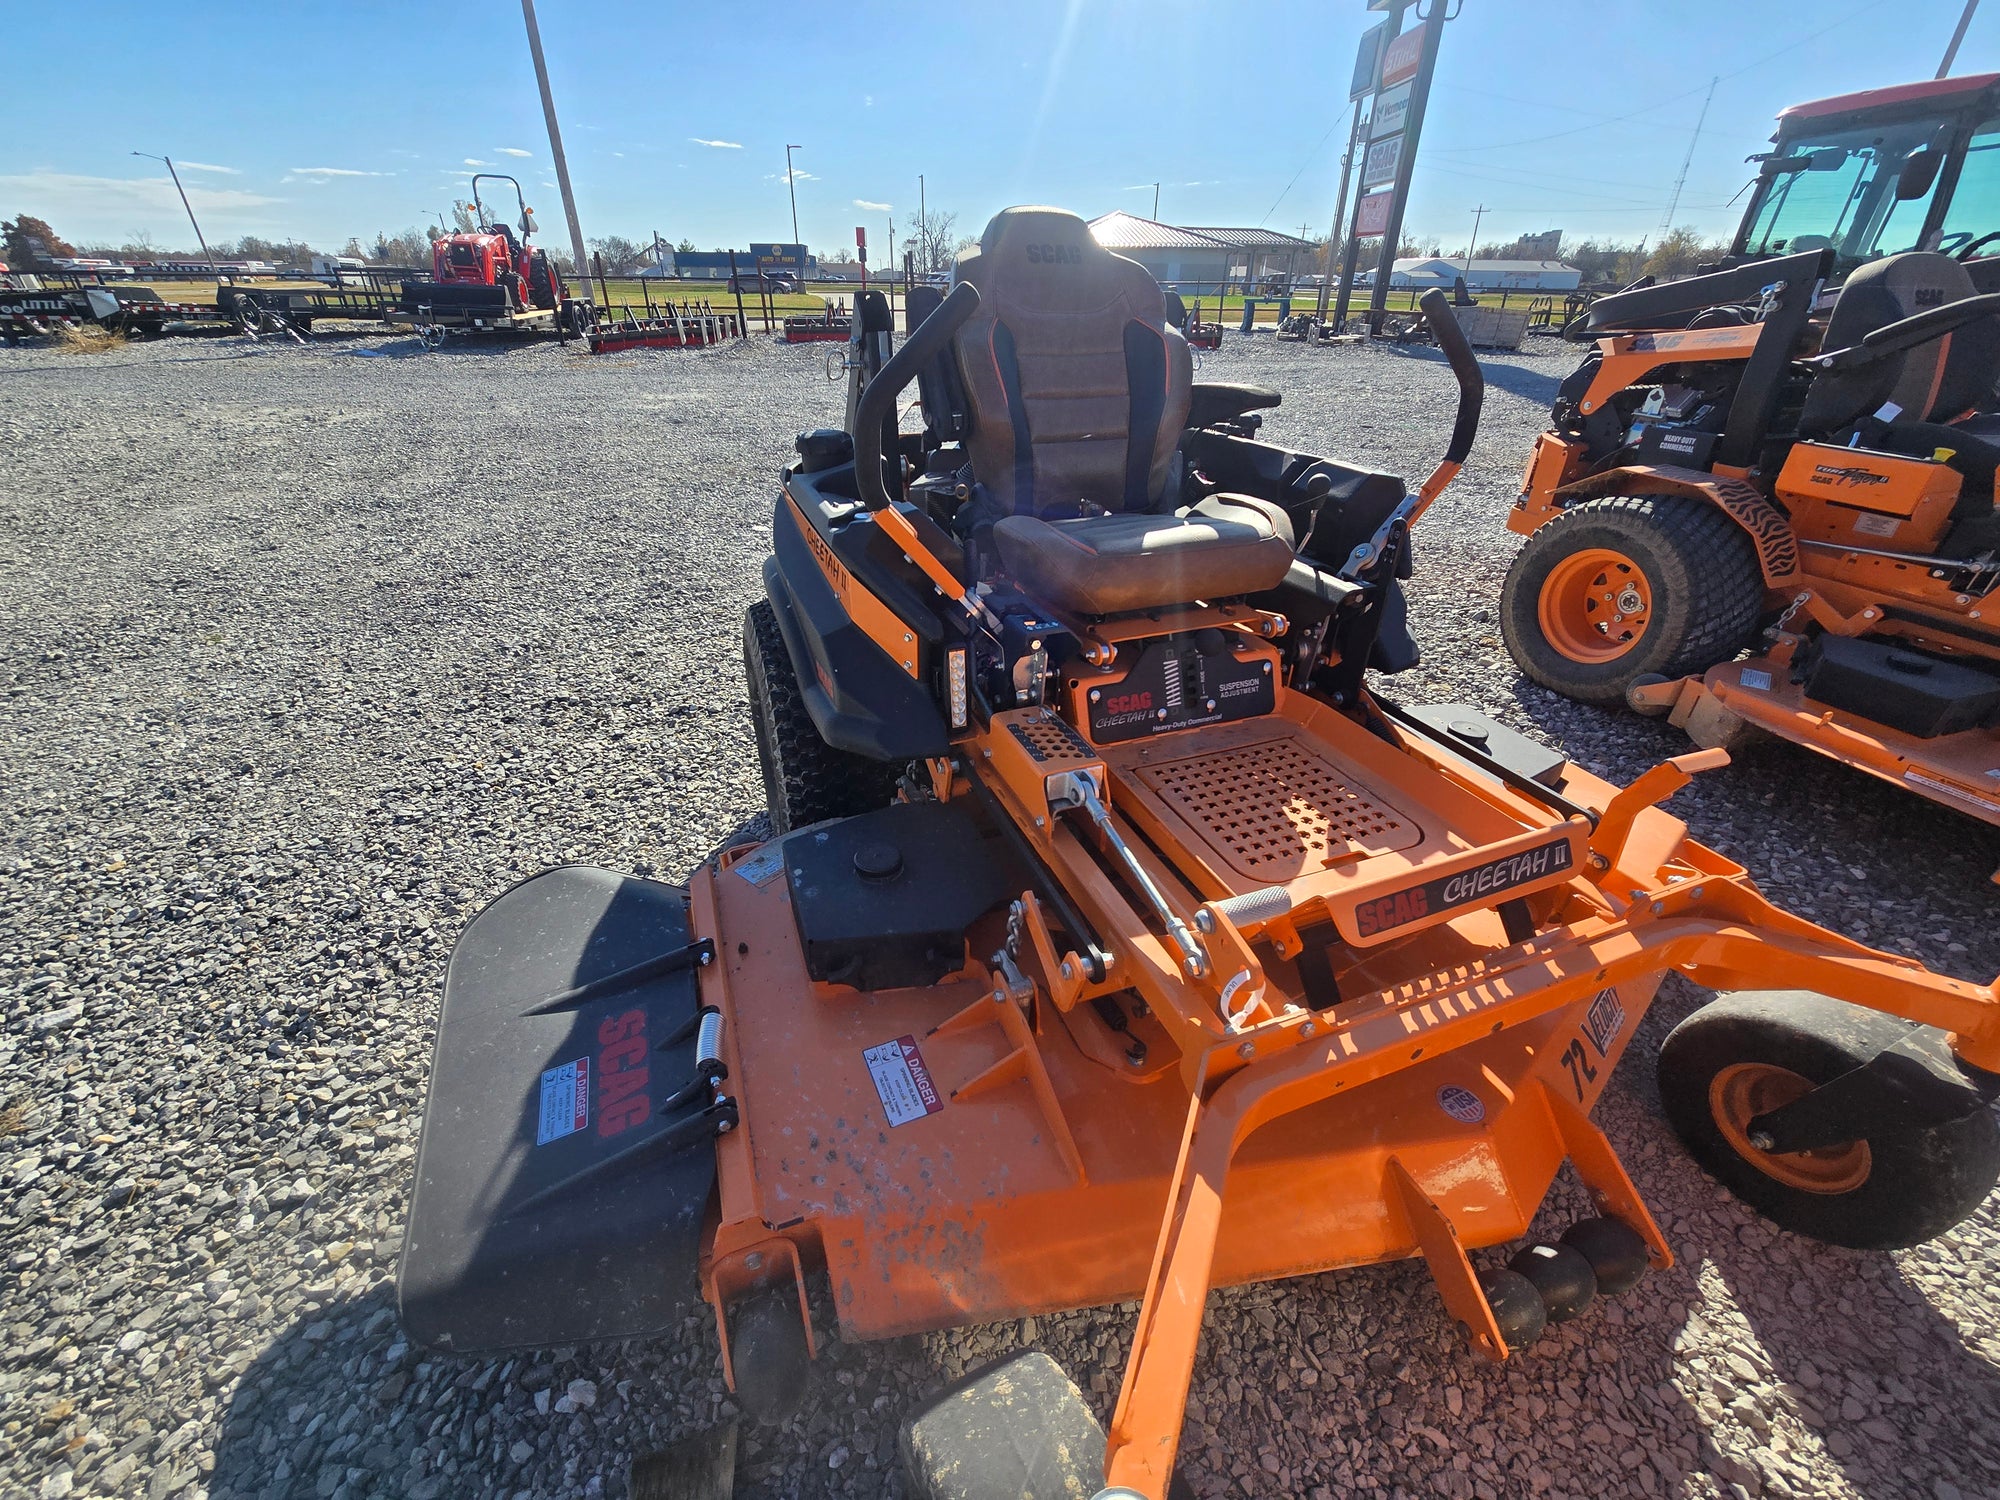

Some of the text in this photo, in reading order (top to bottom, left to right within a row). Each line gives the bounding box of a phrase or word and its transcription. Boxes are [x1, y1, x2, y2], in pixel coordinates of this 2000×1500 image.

[1368, 141, 1398, 171] SCAG
[1026, 243, 1081, 264] SCAG
[22, 300, 67, 310] LITTLE
[1915, 289, 1944, 306] SCAG
[1810, 475, 1833, 485] SCAG
[806, 527, 839, 583] CHEETAH
[1219, 678, 1260, 692] SUSPENSION
[1220, 686, 1260, 698] ADJUSTMENT
[1107, 691, 1152, 714] SCAG
[1095, 710, 1148, 729] CHEETAH
[1152, 713, 1222, 732] Heavy-Duty Commercial
[1357, 888, 1428, 934] SCAG
[1443, 848, 1550, 903] CHEETAH
[1579, 985, 1622, 1058] VELOCITY
[597, 1009, 651, 1138] SCAG
[908, 1058, 936, 1105] DANGER
[1560, 1038, 1597, 1103] 72
[576, 1079, 586, 1118] DANGER
[1452, 1091, 1479, 1109] USA
